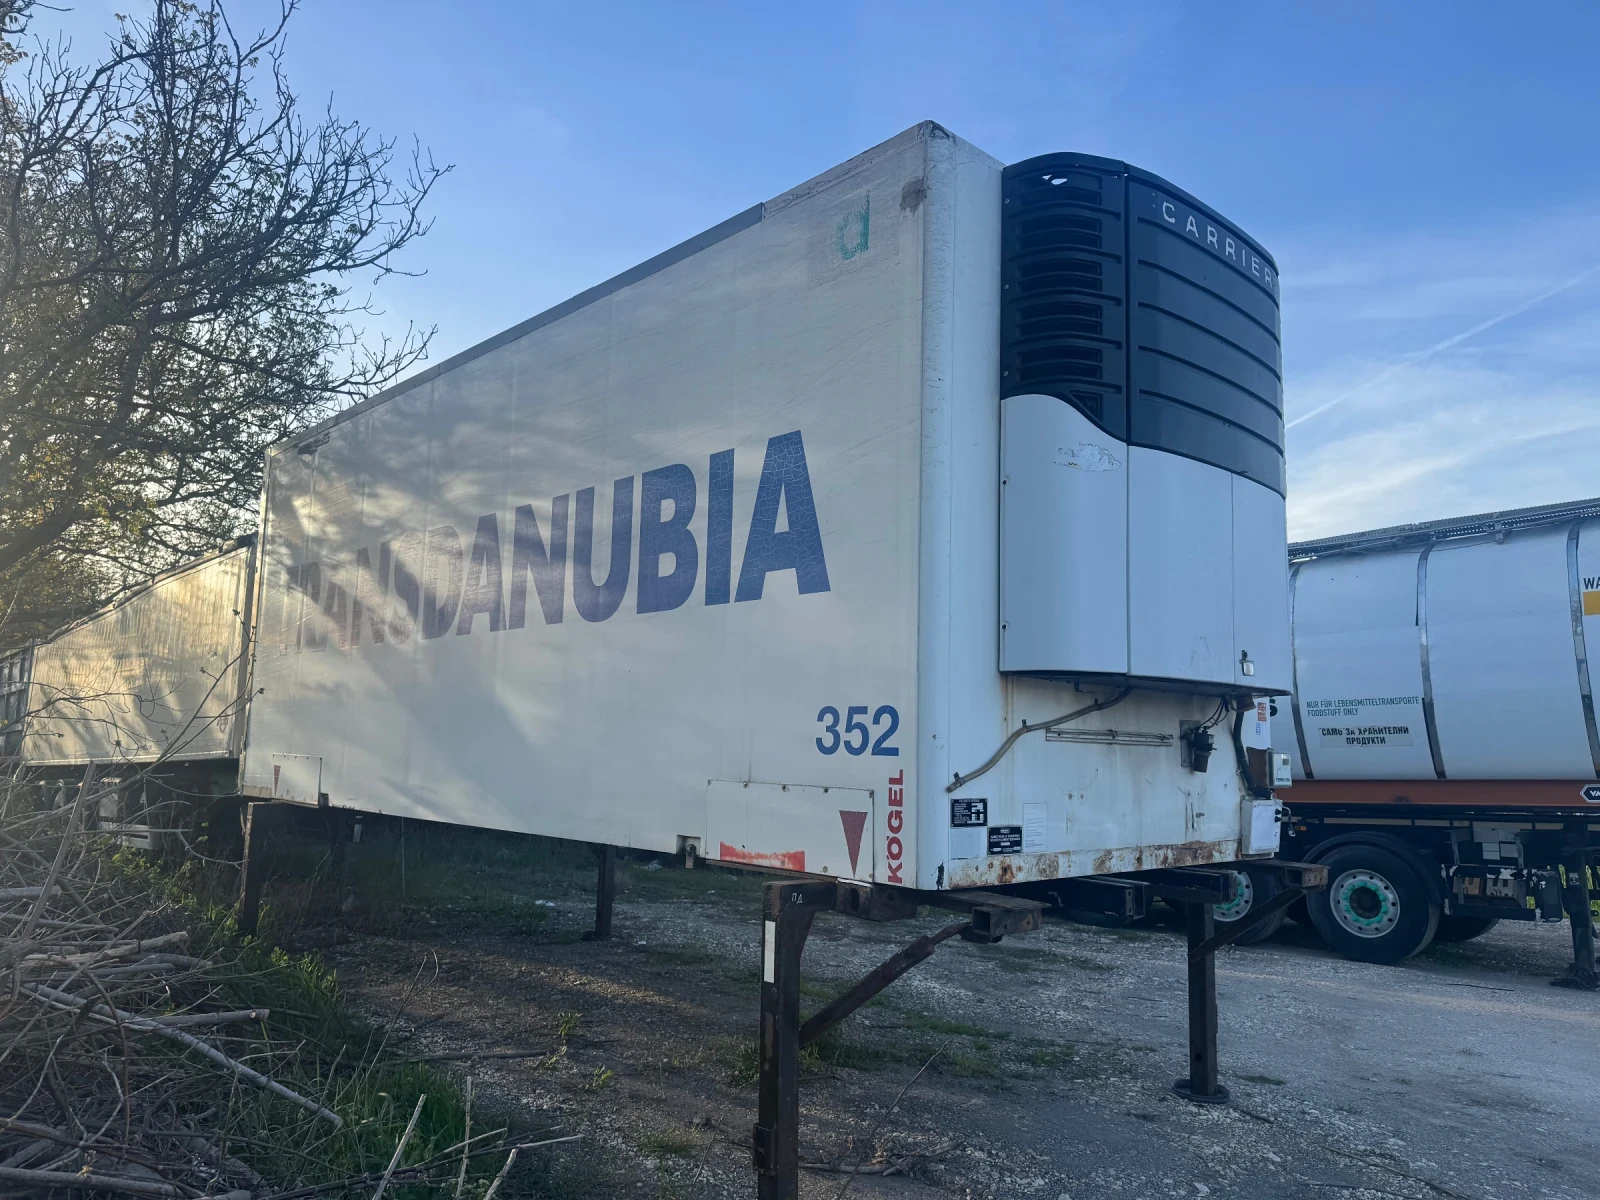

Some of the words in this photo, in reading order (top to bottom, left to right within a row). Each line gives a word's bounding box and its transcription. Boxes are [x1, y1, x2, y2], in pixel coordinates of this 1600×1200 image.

[1162, 201, 1273, 288] CARRIER
[1306, 700, 1319, 709] NUR
[1321, 699, 1333, 709] FÜR
[1334, 696, 1420, 708] LEBENSMITTELTRANSPORTE
[1307, 708, 1341, 717] FOODSTUFF
[1343, 707, 1359, 716] ONLY
[816, 704, 900, 757] 352
[1346, 736, 1386, 746] ПРОДУКТИ
[886, 768, 904, 885] KÖGEL
